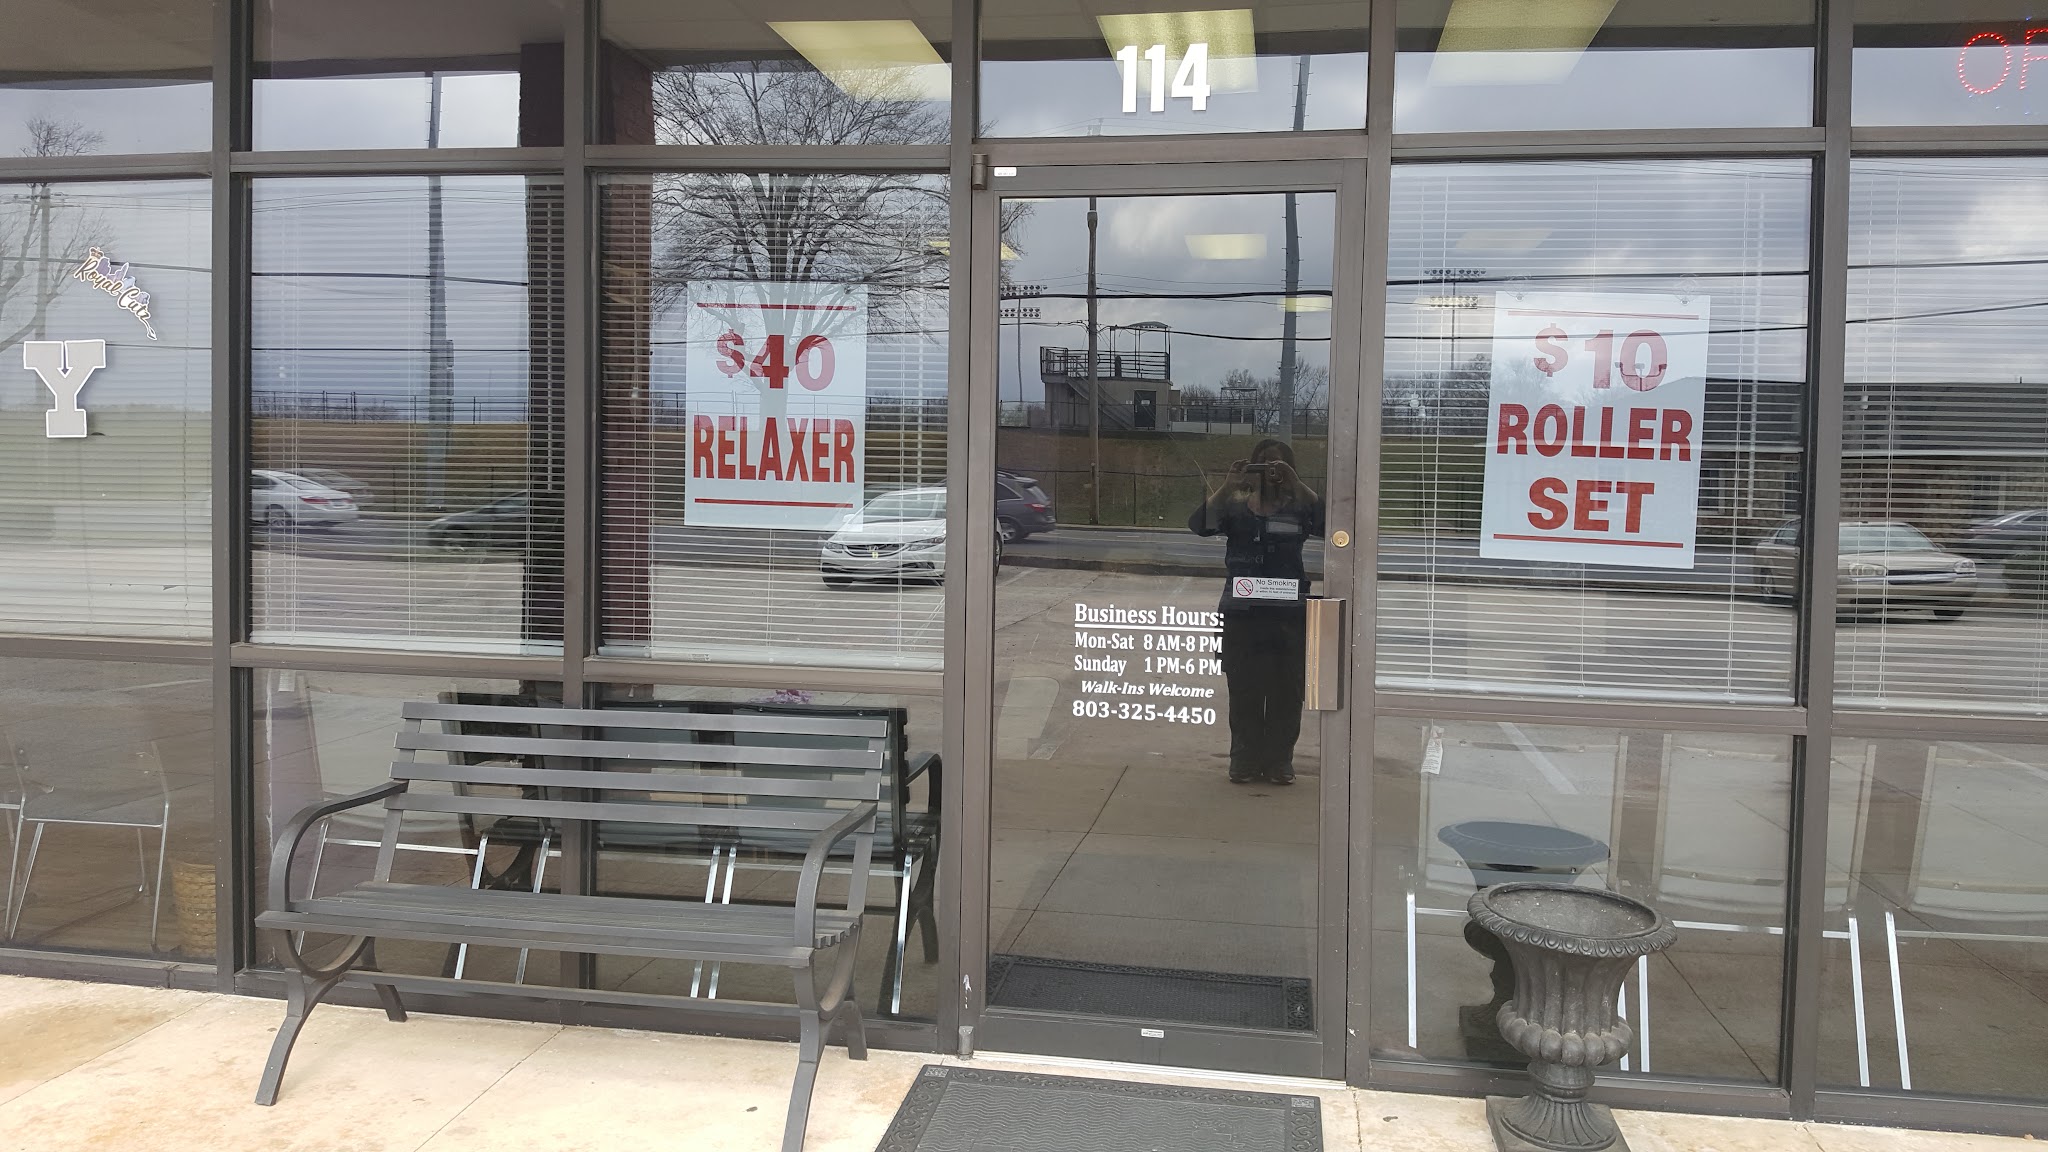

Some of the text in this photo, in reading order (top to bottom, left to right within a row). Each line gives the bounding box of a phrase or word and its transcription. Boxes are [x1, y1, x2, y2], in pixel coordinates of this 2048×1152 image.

[1116, 43, 1211, 113] 114
[74, 257, 151, 326] Royal Cutz
[716, 329, 835, 391] $40
[693, 415, 855, 483] RELAXER
[1497, 403, 1693, 461] ROLLER
[1527, 477, 1655, 533] SET
[1267, 579, 1297, 588] Smoking
[1074, 603, 1225, 627] Business Hours:
[1074, 632, 1223, 653] Mon-Sat 8 AM-8 PM
[1074, 655, 1222, 676] Sunday 1 PM-6 PM
[1081, 680, 1215, 698] Walk-Ins Welcome
[1072, 700, 1217, 725] 803-325-4450
